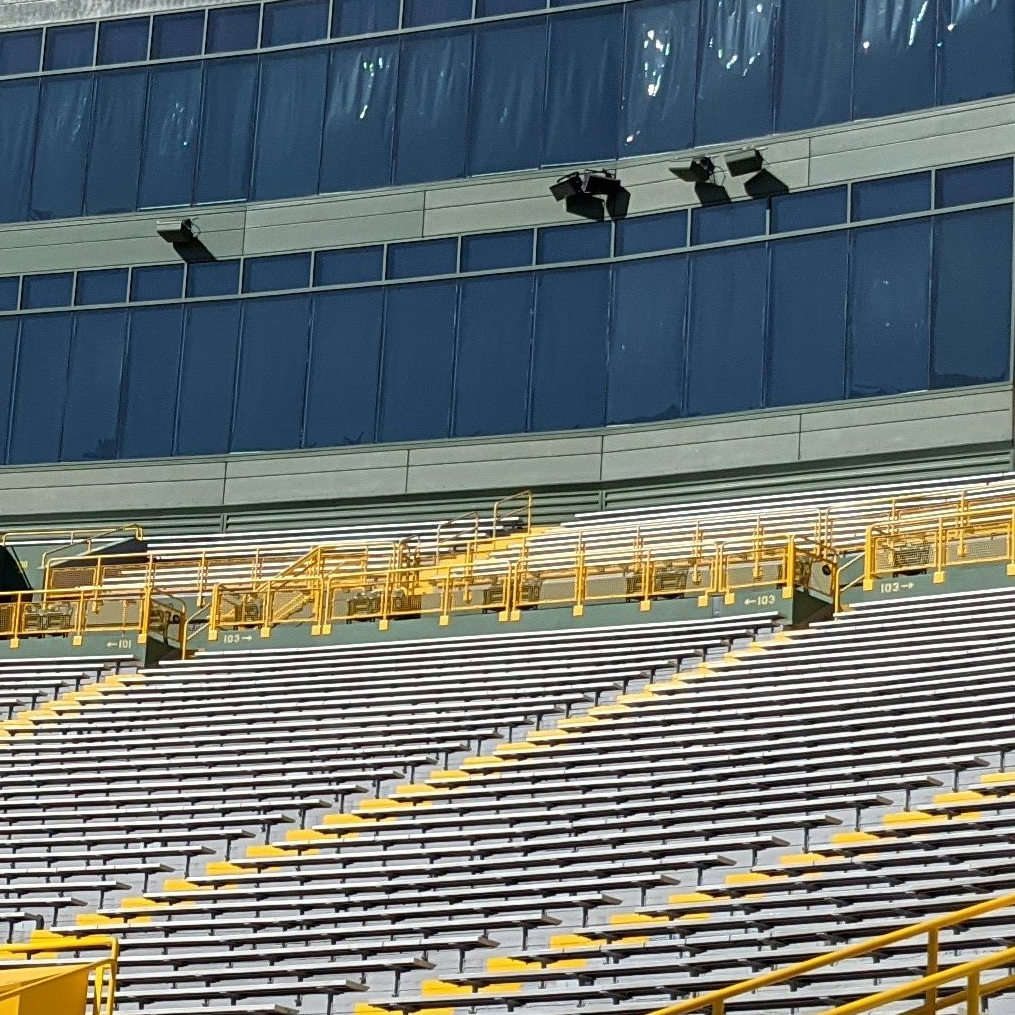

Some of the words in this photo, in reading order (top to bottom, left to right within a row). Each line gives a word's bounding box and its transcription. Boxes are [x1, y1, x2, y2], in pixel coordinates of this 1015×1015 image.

[881, 582, 900, 593] 103
[757, 595, 775, 606] 103
[118, 639, 132, 649] 101
[223, 634, 240, 644] 103
